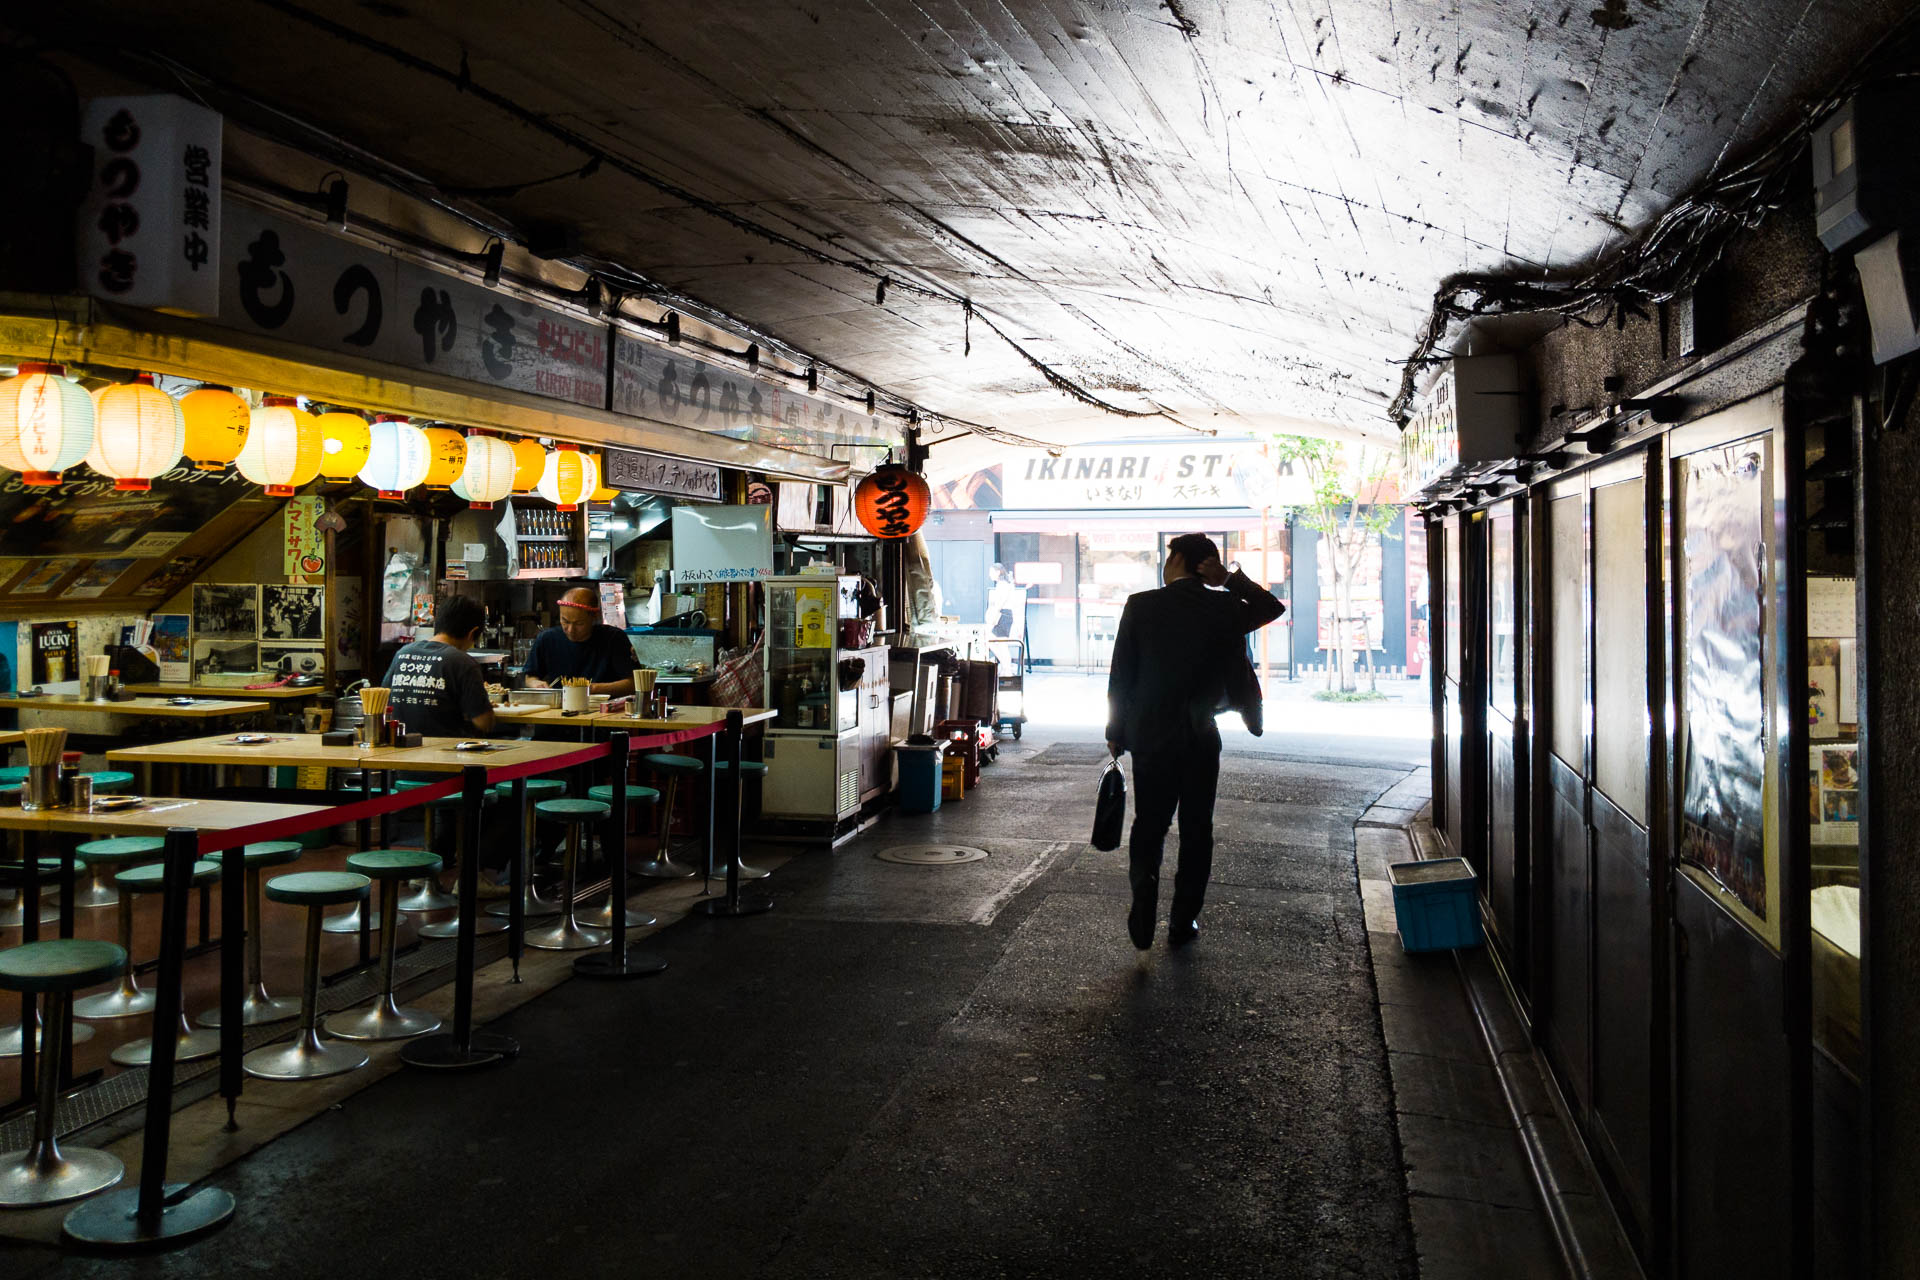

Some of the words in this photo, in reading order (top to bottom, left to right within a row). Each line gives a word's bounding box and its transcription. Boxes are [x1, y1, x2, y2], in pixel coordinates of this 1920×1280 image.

[98, 108, 141, 294] もつやき
[184, 143, 212, 272] 営業中
[237, 229, 516, 381] もつやき
[537, 318, 605, 369] キリンビール
[536, 370, 571, 398] KIRIN
[574, 377, 604, 402] BEER
[658, 358, 763, 430] もつやき
[1024, 456, 1150, 480] IKINARI
[1177, 455, 1294, 478] STK
[1086, 485, 1142, 500] いきなり
[1173, 484, 1220, 499] ステーキ
[874, 473, 911, 536] もつやき
[287, 499, 302, 574] トマトサワー
[39, 633, 71, 649] LUCKY
[399, 662, 433, 674] もつやき
